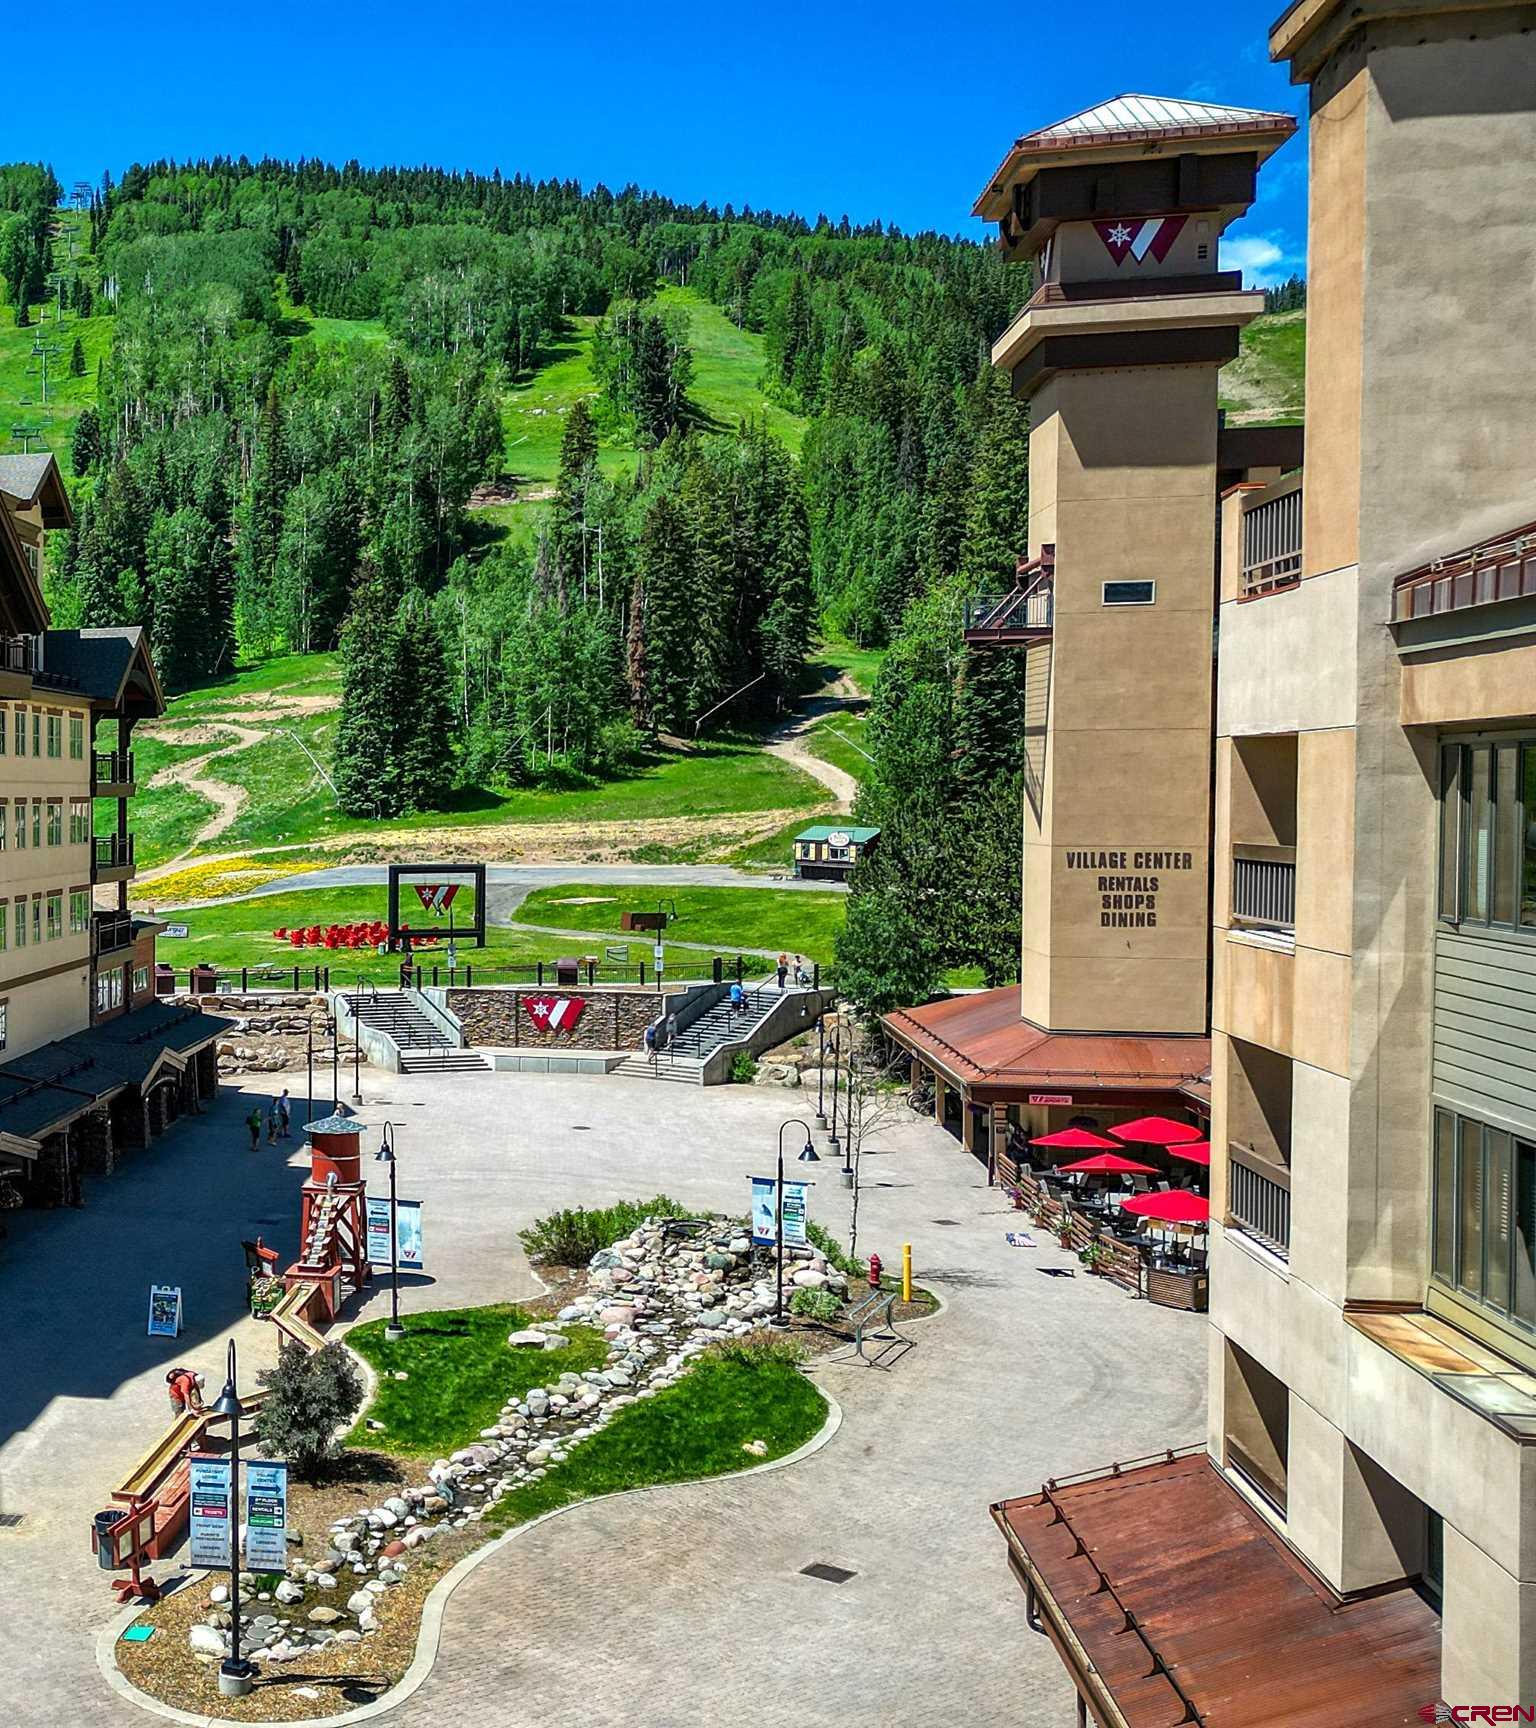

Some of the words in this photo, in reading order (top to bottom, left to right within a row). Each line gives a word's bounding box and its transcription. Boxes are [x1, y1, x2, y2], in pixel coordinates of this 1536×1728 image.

[1065, 851, 1127, 870] VILLAGE
[1133, 851, 1193, 870] CENTER
[1097, 876, 1159, 892] RENTALS
[1101, 894, 1156, 910] SHOPS
[1100, 911, 1157, 928] DINING
